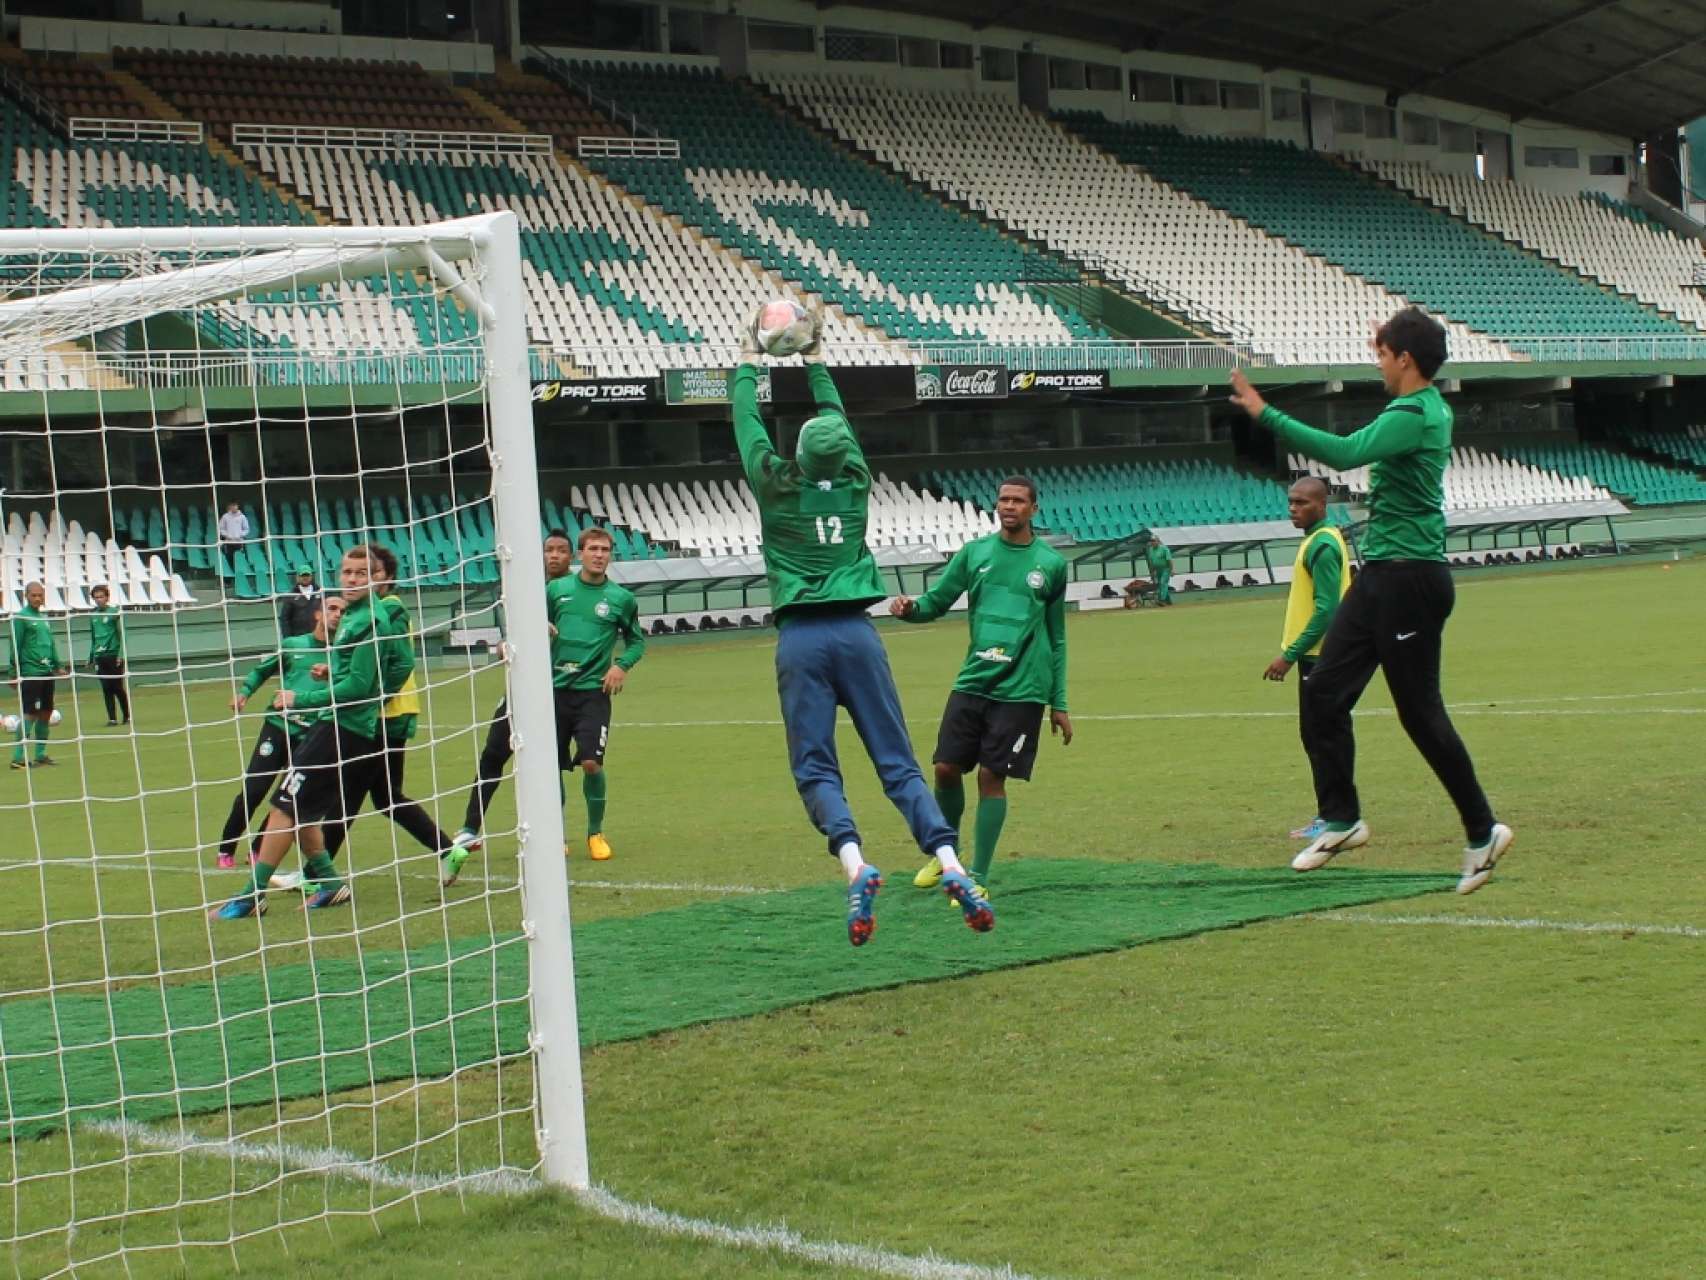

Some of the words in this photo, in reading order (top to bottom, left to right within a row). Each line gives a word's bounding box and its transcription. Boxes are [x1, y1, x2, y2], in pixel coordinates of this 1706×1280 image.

[1034, 375, 1065, 386] PRO
[1066, 374, 1103, 386] TORK
[560, 386, 598, 398] PRO
[600, 384, 648, 397] TORK
[815, 516, 844, 544] 12
